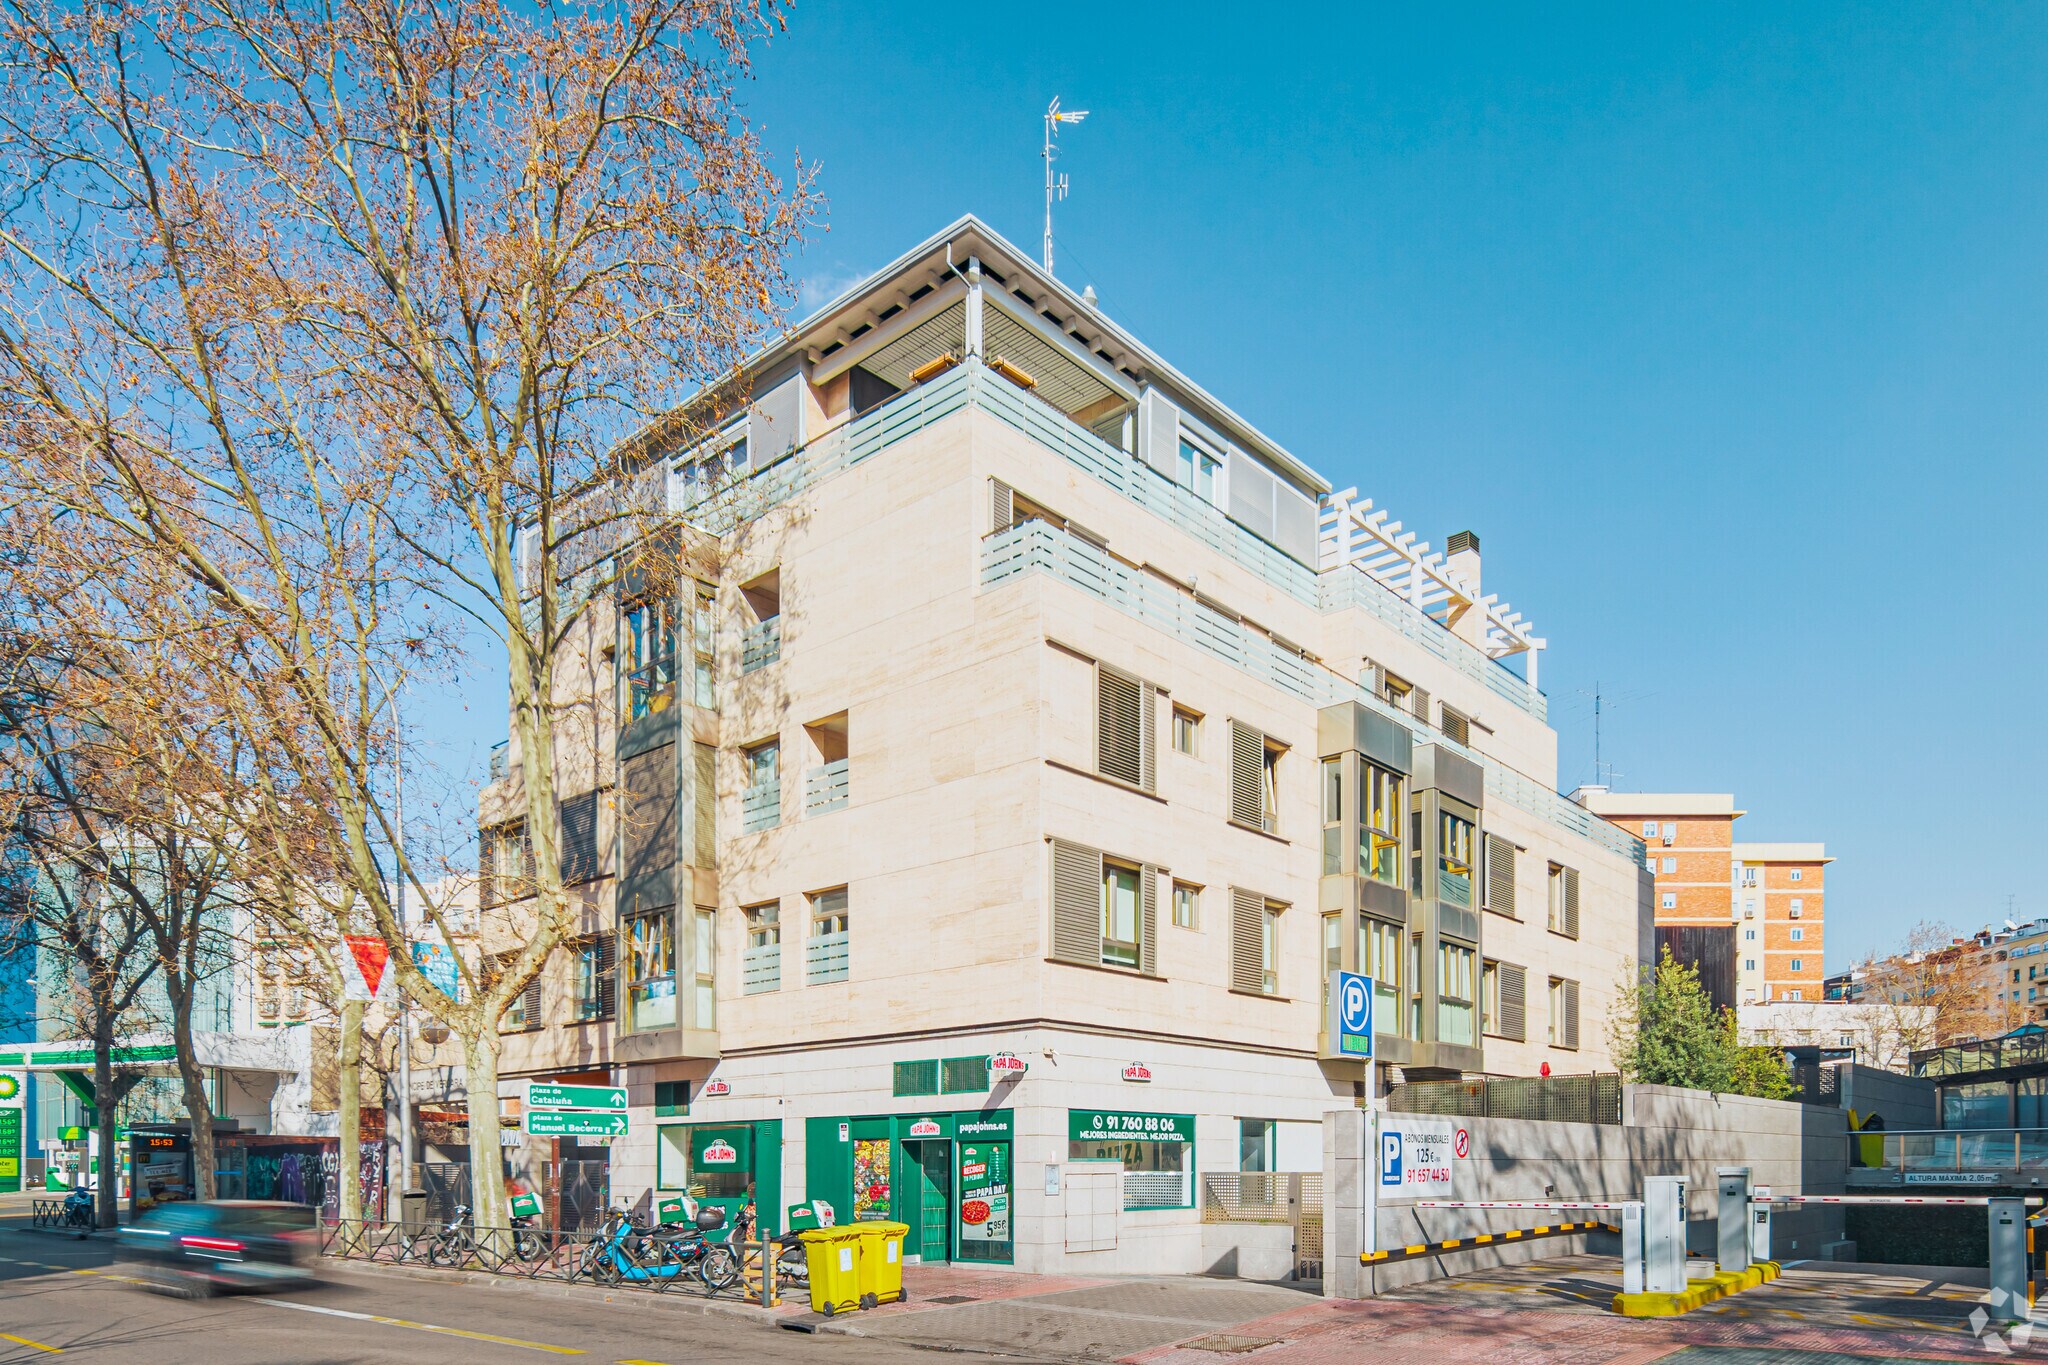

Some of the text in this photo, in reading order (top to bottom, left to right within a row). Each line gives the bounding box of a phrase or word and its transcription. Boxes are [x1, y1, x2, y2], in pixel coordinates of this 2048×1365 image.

[1348, 986, 1363, 1021] P
[531, 1095, 572, 1105] Cataluña
[532, 1123, 603, 1132] Manuel Becerra
[959, 1121, 1008, 1134] papajohns.es
[1106, 1115, 1174, 1131] 91 760 88 06
[1080, 1131, 1107, 1139] MEJORES
[1108, 1132, 1148, 1140] INGREDIENTES.
[1405, 1134, 1449, 1144] ABONOS MENSUALES
[1384, 1136, 1400, 1173] P
[1417, 1149, 1429, 1163] 125
[1408, 1169, 1416, 1183] 91
[1418, 1168, 1430, 1182] 657
[1432, 1168, 1440, 1182] 44
[1441, 1168, 1449, 1182] 50
[1939, 1174, 1967, 1182] MÁXIMA
[977, 1186, 993, 1198] PAPA
[994, 1184, 1006, 1194] DAY
